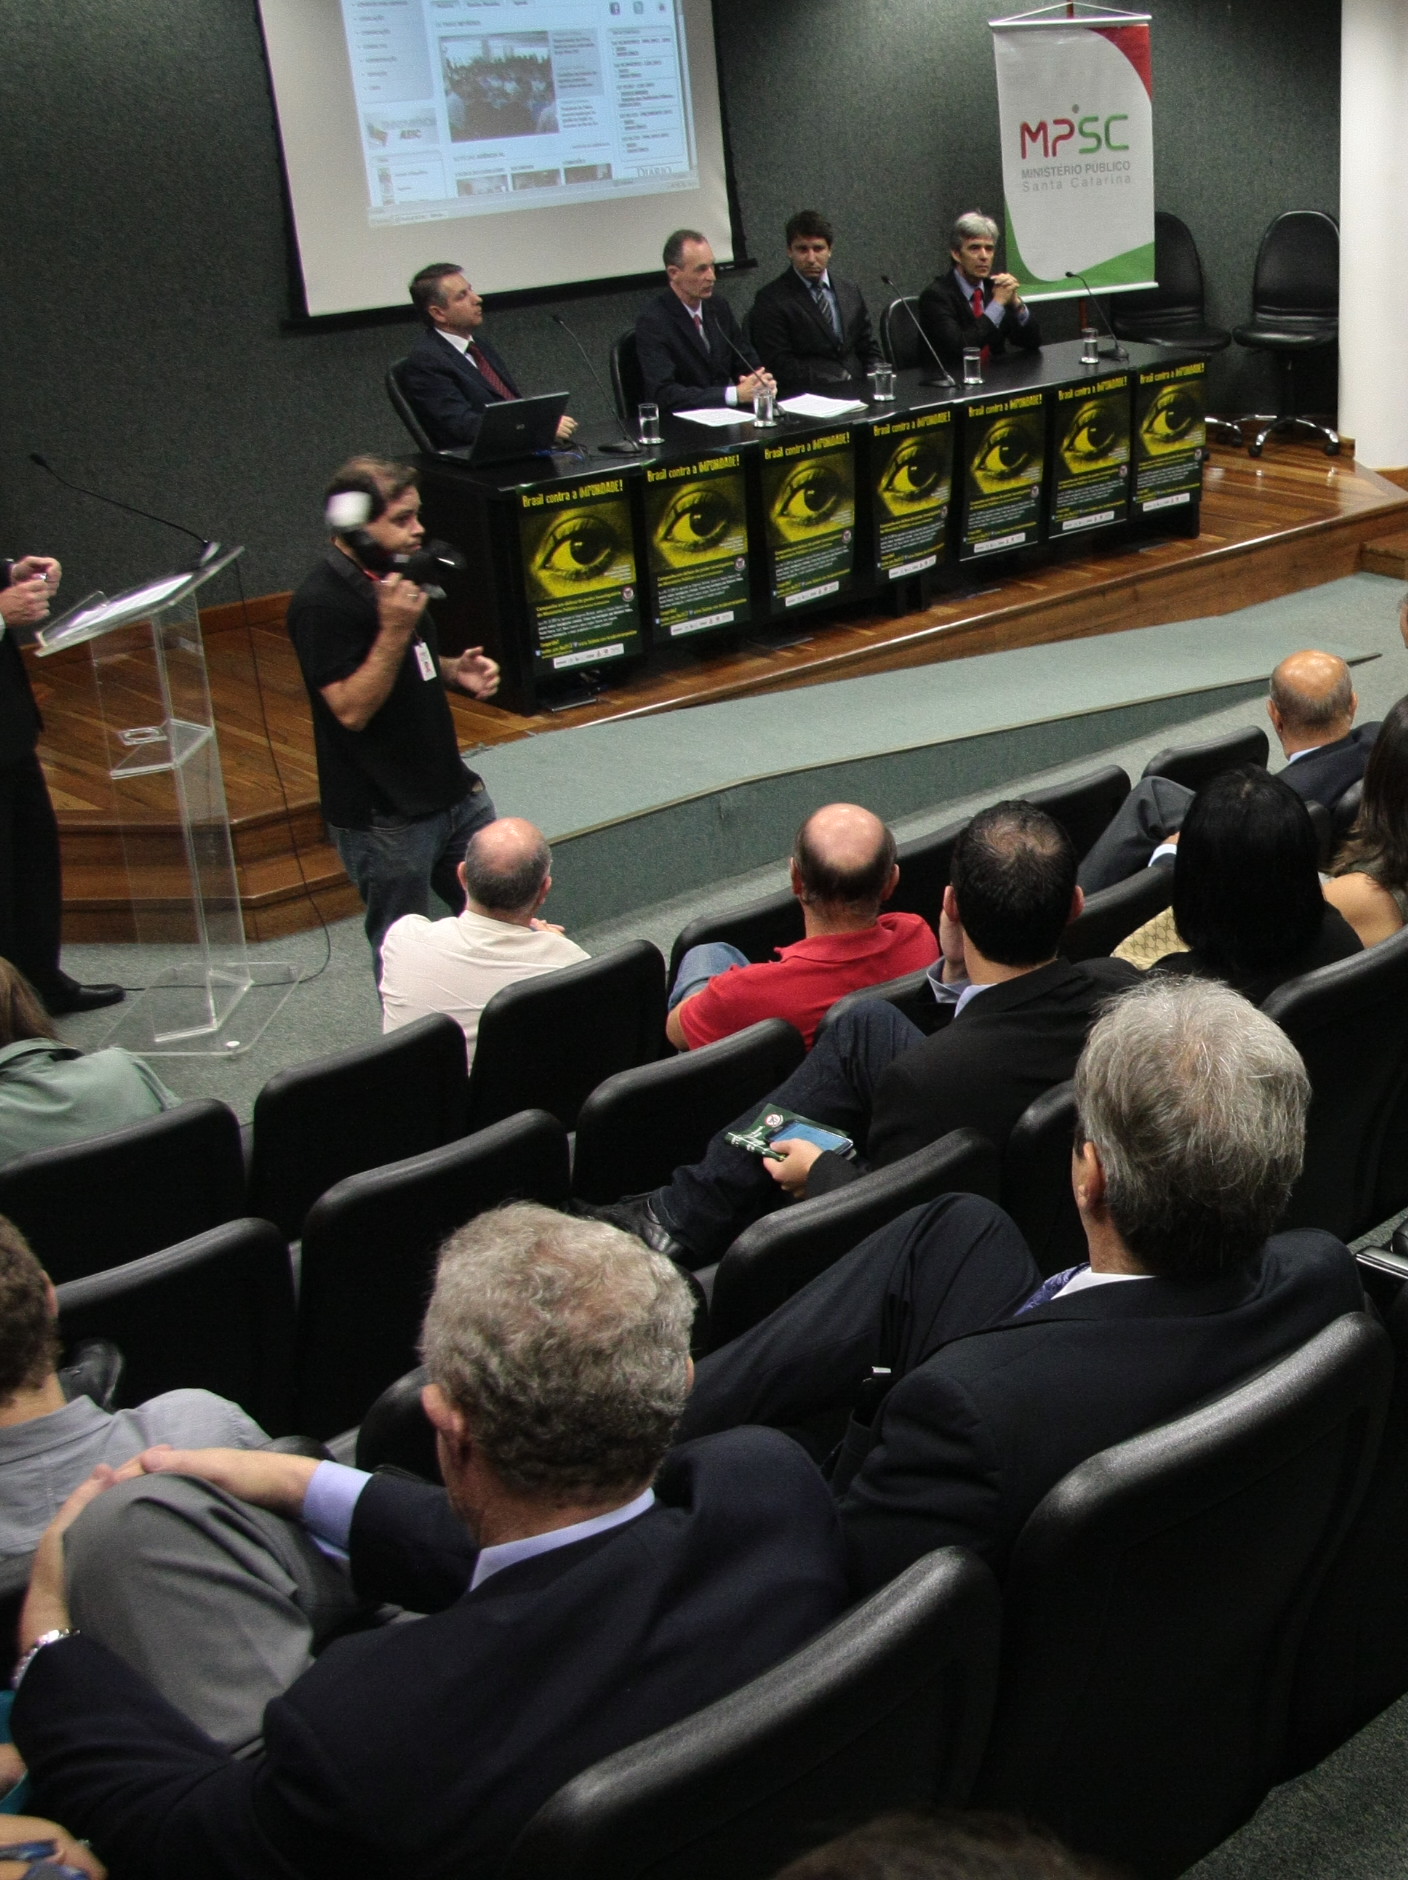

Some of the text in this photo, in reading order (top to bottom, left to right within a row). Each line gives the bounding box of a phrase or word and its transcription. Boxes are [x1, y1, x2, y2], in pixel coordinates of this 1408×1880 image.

[1020, 114, 1130, 160] MPSC
[1022, 175, 1131, 192] Santa Catarina
[522, 494, 544, 508] Brasil
